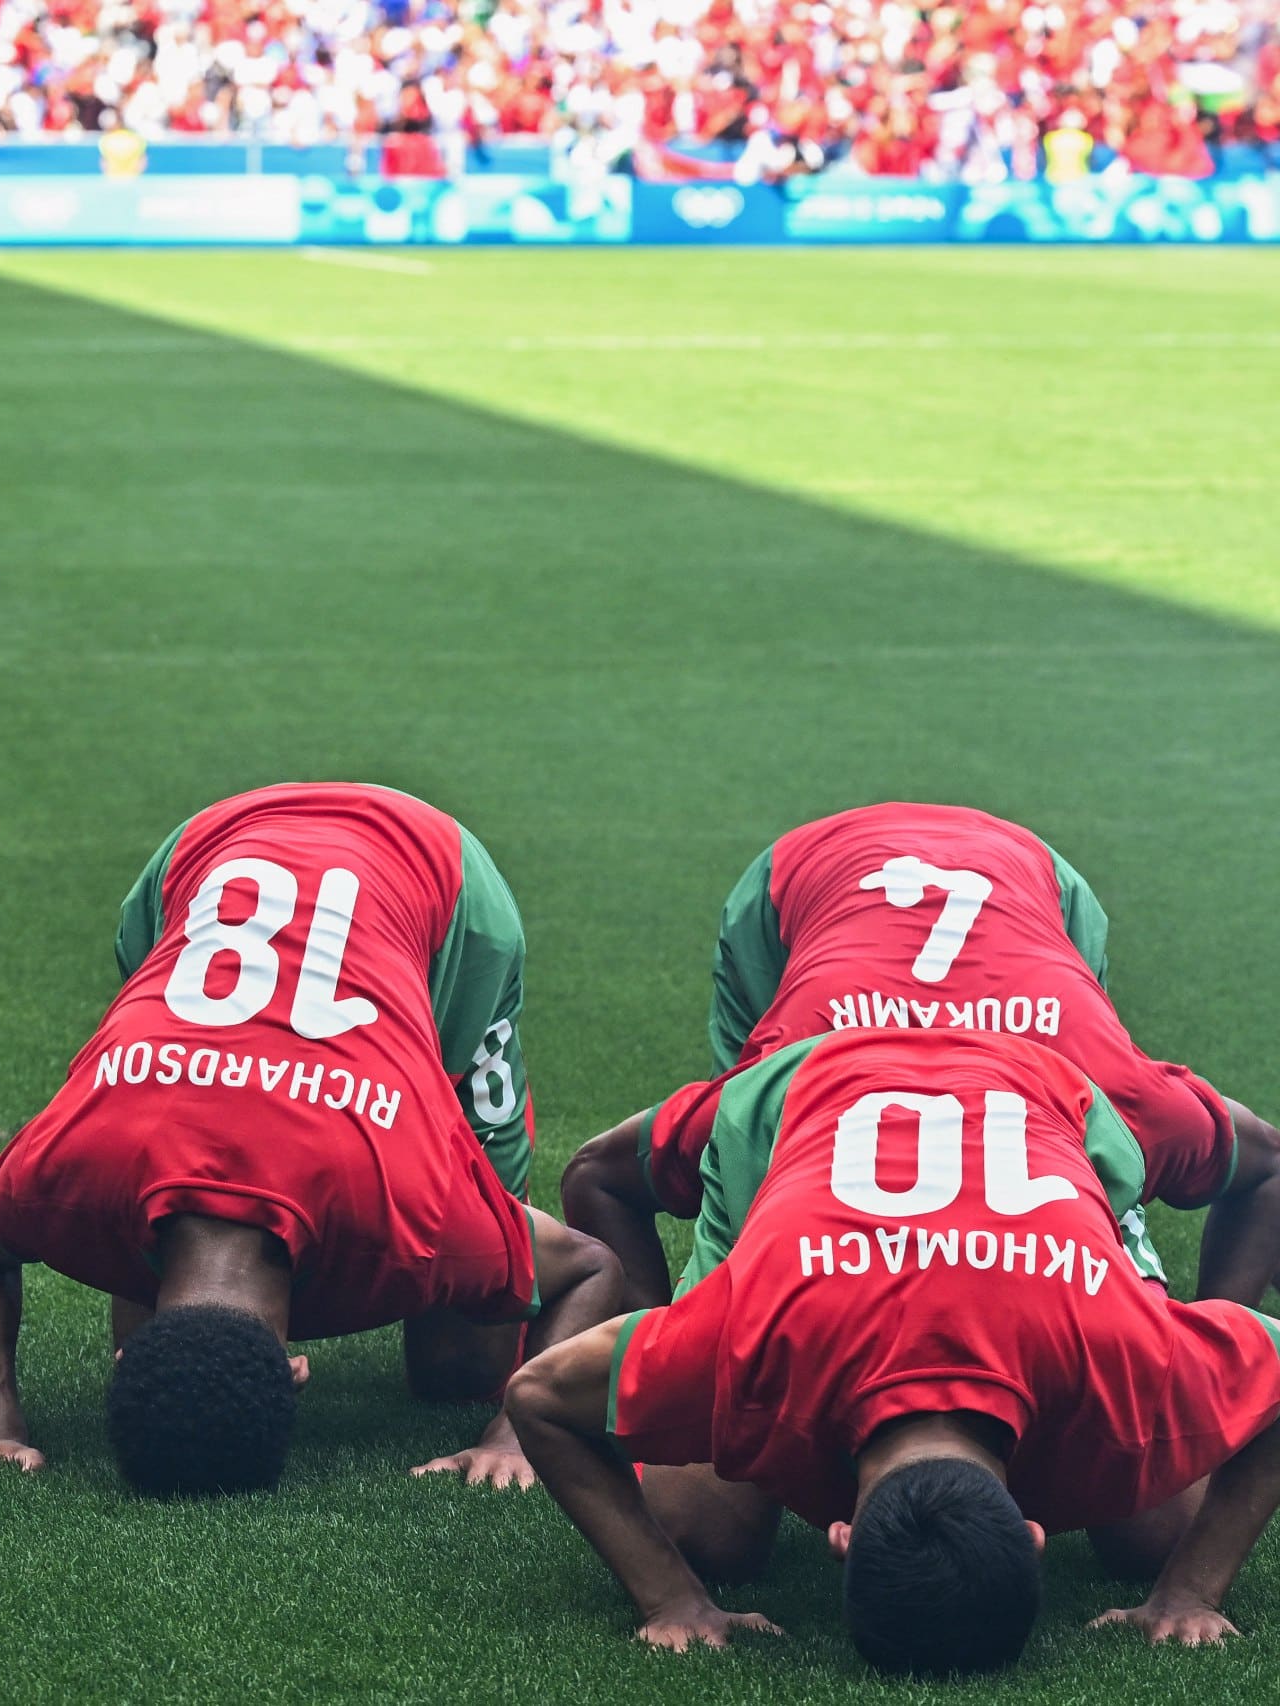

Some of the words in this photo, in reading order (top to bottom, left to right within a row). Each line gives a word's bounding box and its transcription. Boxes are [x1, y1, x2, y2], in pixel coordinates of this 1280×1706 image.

[163, 857, 380, 1040] 18
[858, 855, 994, 983] 4
[828, 991, 1061, 1036] BOUKAMIR
[93, 1041, 402, 1130] RICHARDSON
[830, 1090, 1080, 1218] 10
[799, 1225, 1109, 1296] AKHOMACH
